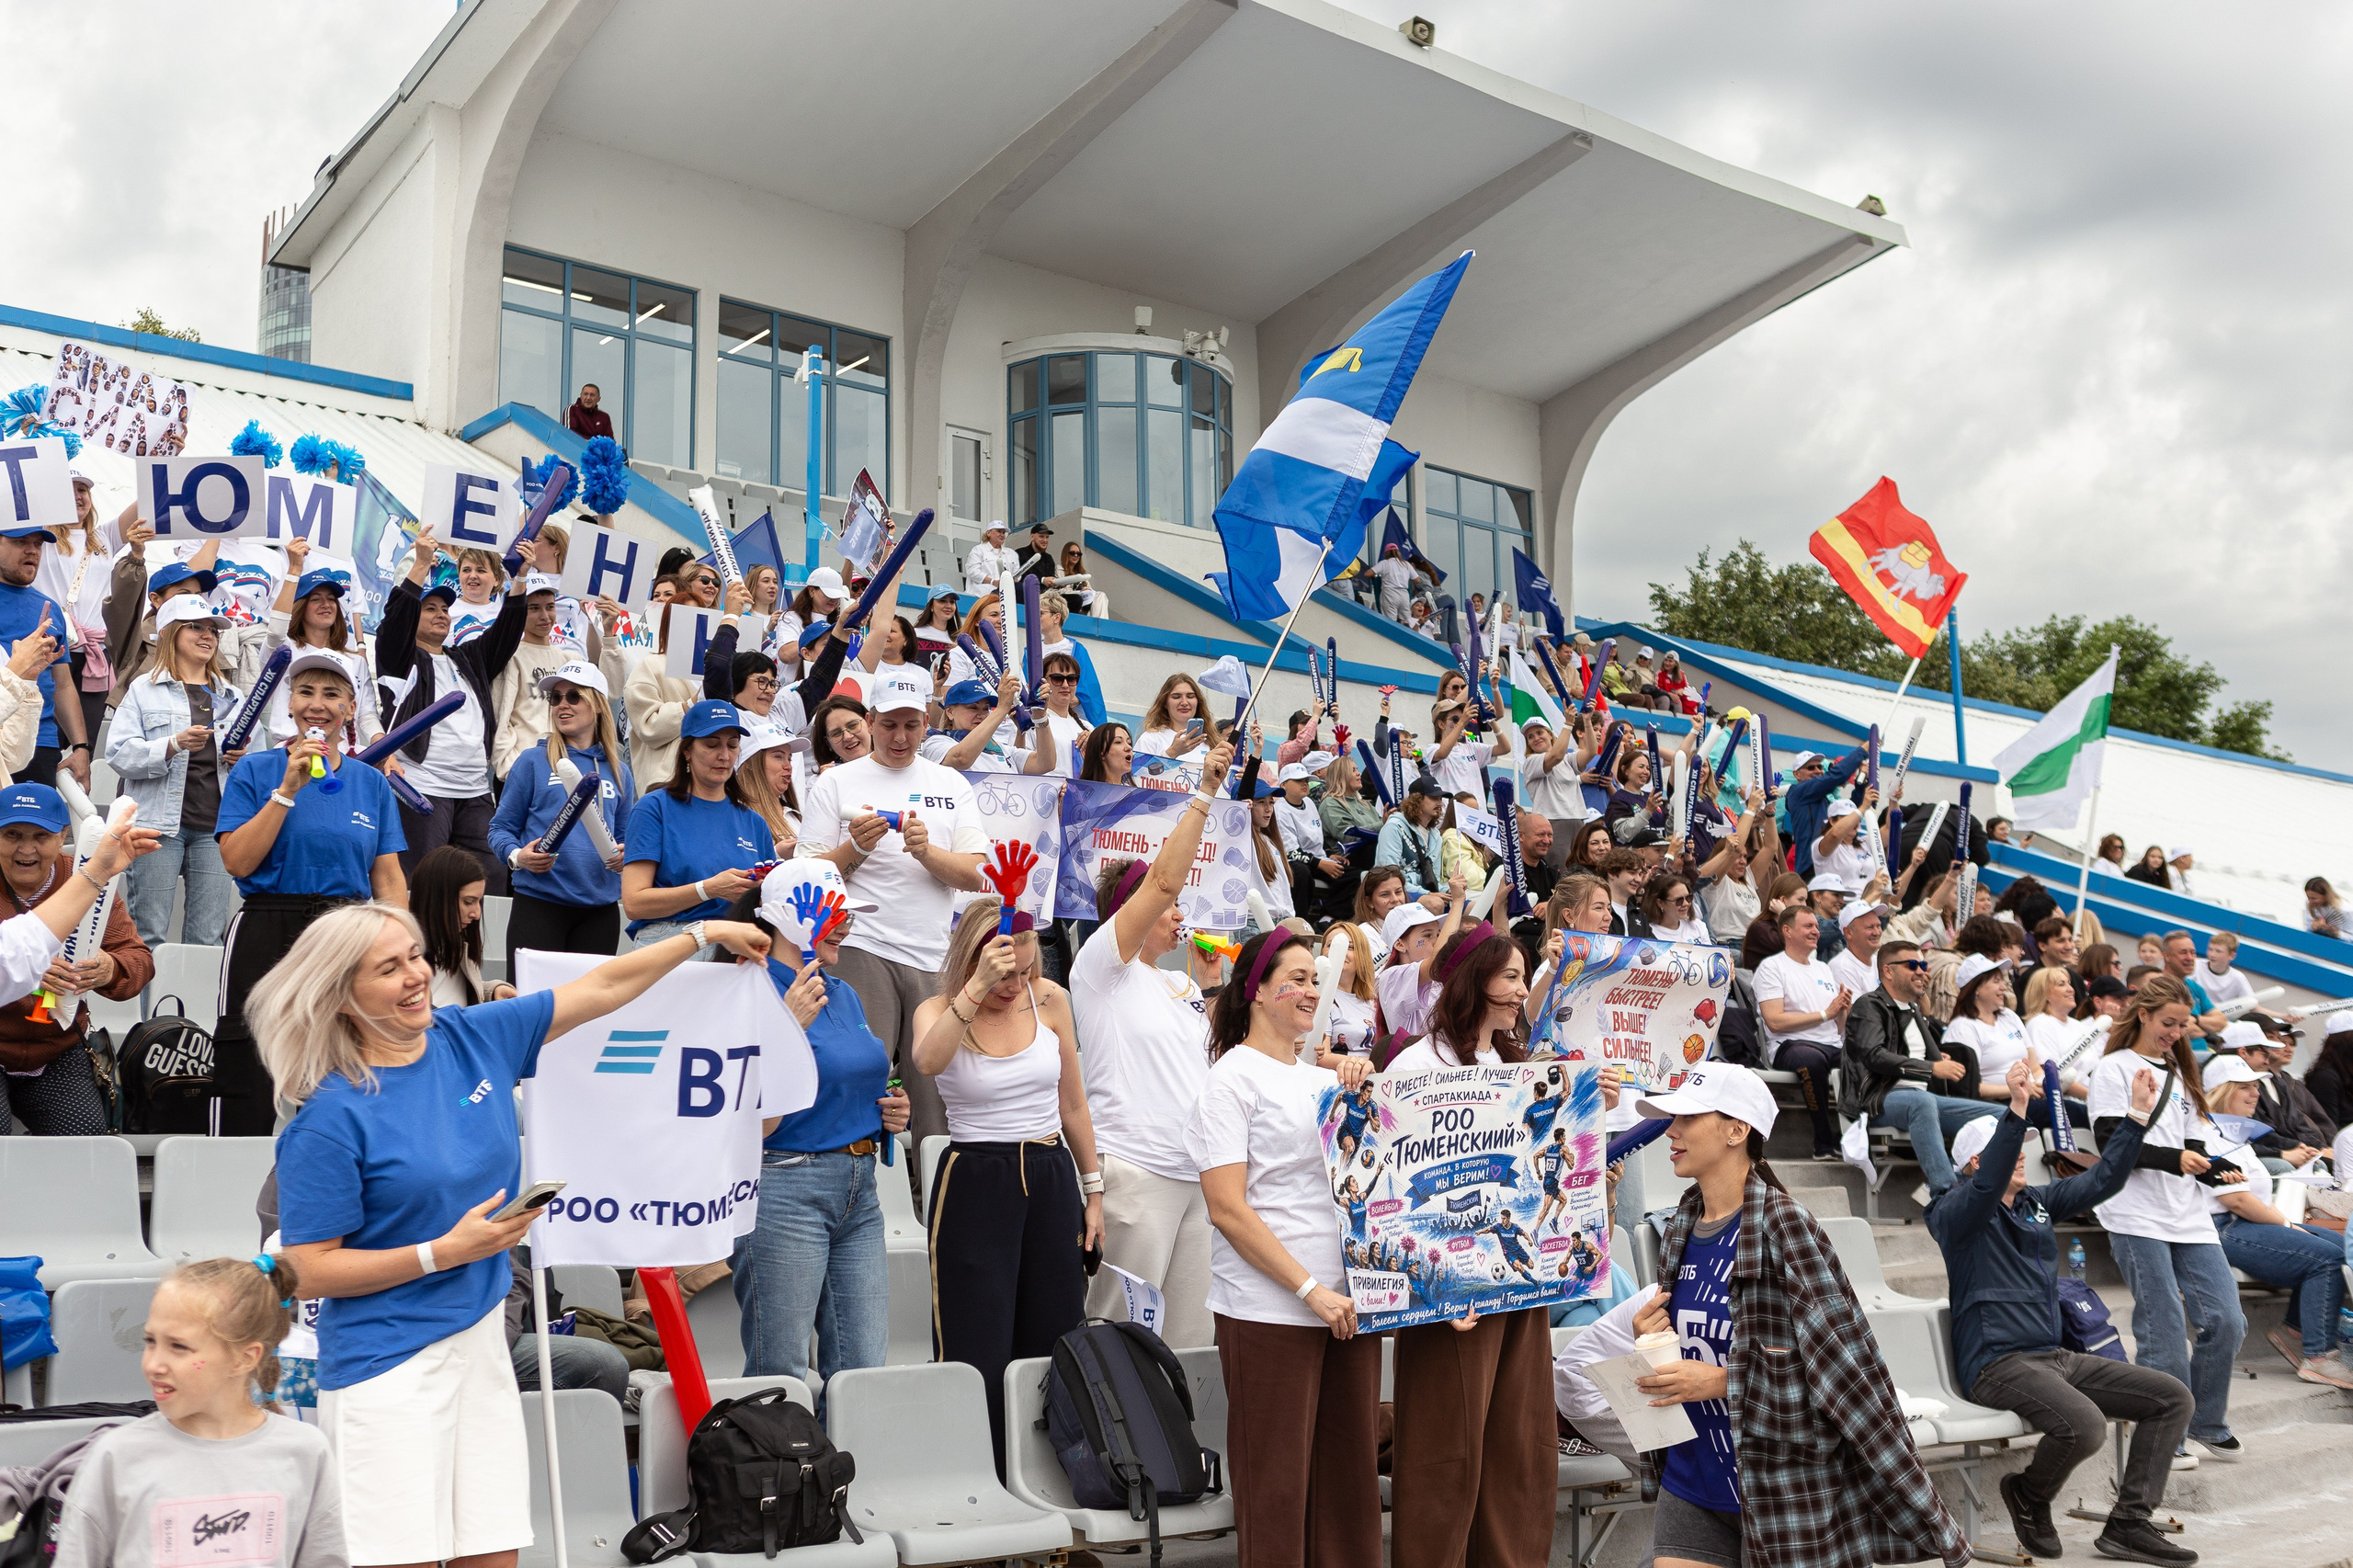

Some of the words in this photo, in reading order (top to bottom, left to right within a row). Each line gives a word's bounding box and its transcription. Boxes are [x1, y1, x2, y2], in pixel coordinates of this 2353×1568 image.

[152, 462, 250, 535] Ю
[450, 472, 498, 545] Е
[267, 475, 334, 550] М
[700, 509, 732, 578] СПАРТАКИАДА
[587, 532, 639, 604] Н
[619, 632, 654, 648] МАЛ
[261, 668, 277, 685] XII
[563, 665, 582, 674] ВТБ
[972, 657, 998, 688] ГРУППЫ
[898, 683, 915, 692] ВТБ
[227, 683, 269, 745] СПАРТАКИАДА
[1751, 739, 1759, 791] СПАРТАКИАДА
[1393, 752, 1404, 806] СПАРТАКИАДА
[571, 792, 582, 806] XII
[925, 796, 955, 810] ВТБ
[1507, 801, 1516, 818] XII
[1685, 779, 1697, 836] СПАРТАКИАДА
[539, 802, 576, 853] СПАРТАКИАДА
[1091, 828, 1149, 854] ТЮМЕНЬ
[1497, 819, 1510, 863] ГРУППЫ
[1509, 818, 1527, 898] СПАРТАКИАДА
[1503, 863, 1514, 884] ВТБ
[1622, 968, 1680, 990] ТЮМЕНЬ!
[1605, 987, 1666, 1010] БЫСТРЕЕ!
[1612, 1011, 1647, 1035] ВЫШЕ!
[1602, 1038, 1653, 1062] СИЛЬНЕЕ!
[469, 1079, 493, 1103] ВТБ
[1394, 1071, 1433, 1098] ВМЕСТЕ!
[1436, 1067, 1479, 1085] СИЛЬНЕЕ!
[1481, 1066, 1520, 1083] ЛУЧШЕ!
[1422, 1091, 1492, 1106] СПАРТАКИАДА
[2052, 1089, 2065, 1130] ГРУППЫ
[1432, 1108, 1474, 1134] РОО
[2058, 1130, 2067, 1150] ВТБ
[1425, 1165, 1453, 1180] КОМАНДА,
[1455, 1163, 1460, 1172] В
[1462, 1158, 1490, 1168] КОТОРУЮ
[1547, 1159, 1555, 1170] 72
[1436, 1178, 1449, 1191] МЫ
[1453, 1167, 1490, 1187] ВЕРИМ!
[1571, 1175, 1589, 1187] БЕГ
[549, 1197, 620, 1223] РОО
[1371, 1201, 1399, 1213] ВОЛЕЙБОЛ
[1449, 1195, 1479, 1210] ТЮМЕНСКИЙ
[1541, 1239, 1569, 1252] БАСКЕТБОЛ
[1353, 1276, 1404, 1291] ПРИВИЛЕГИЯ
[1677, 1265, 1697, 1280] ВТБ
[1366, 1291, 1386, 1307] вами!
[1371, 1314, 1399, 1329] Болеем
[1401, 1304, 1442, 1324] сердцем!
[1444, 1301, 1469, 1315] Верим
[1474, 1292, 1506, 1311] команду!
[1540, 1283, 1562, 1298] вами!
